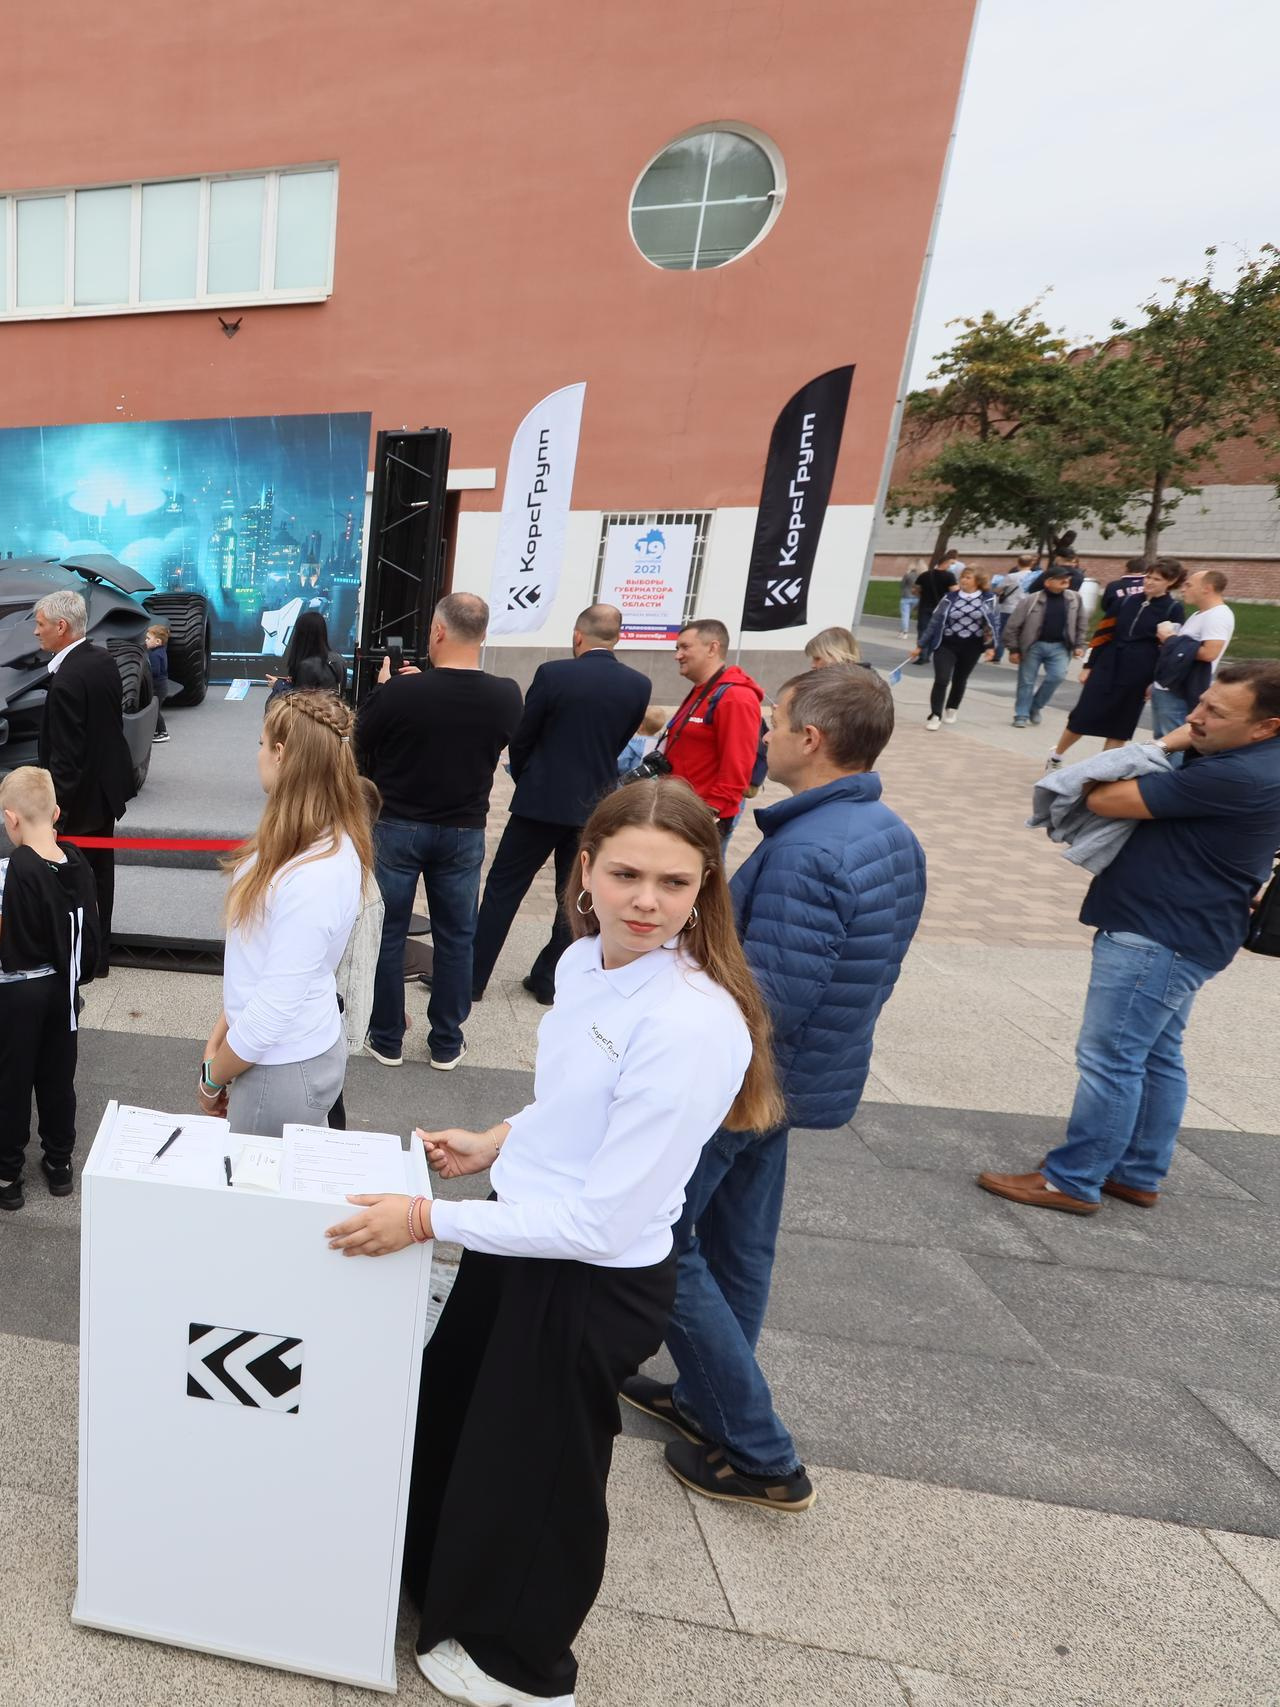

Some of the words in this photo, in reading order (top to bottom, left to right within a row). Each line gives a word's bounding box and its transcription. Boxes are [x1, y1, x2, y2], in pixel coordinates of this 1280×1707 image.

[519, 428, 551, 573] КорсГрупп
[778, 412, 817, 567] КорсГрупп
[634, 564, 662, 574] 2021
